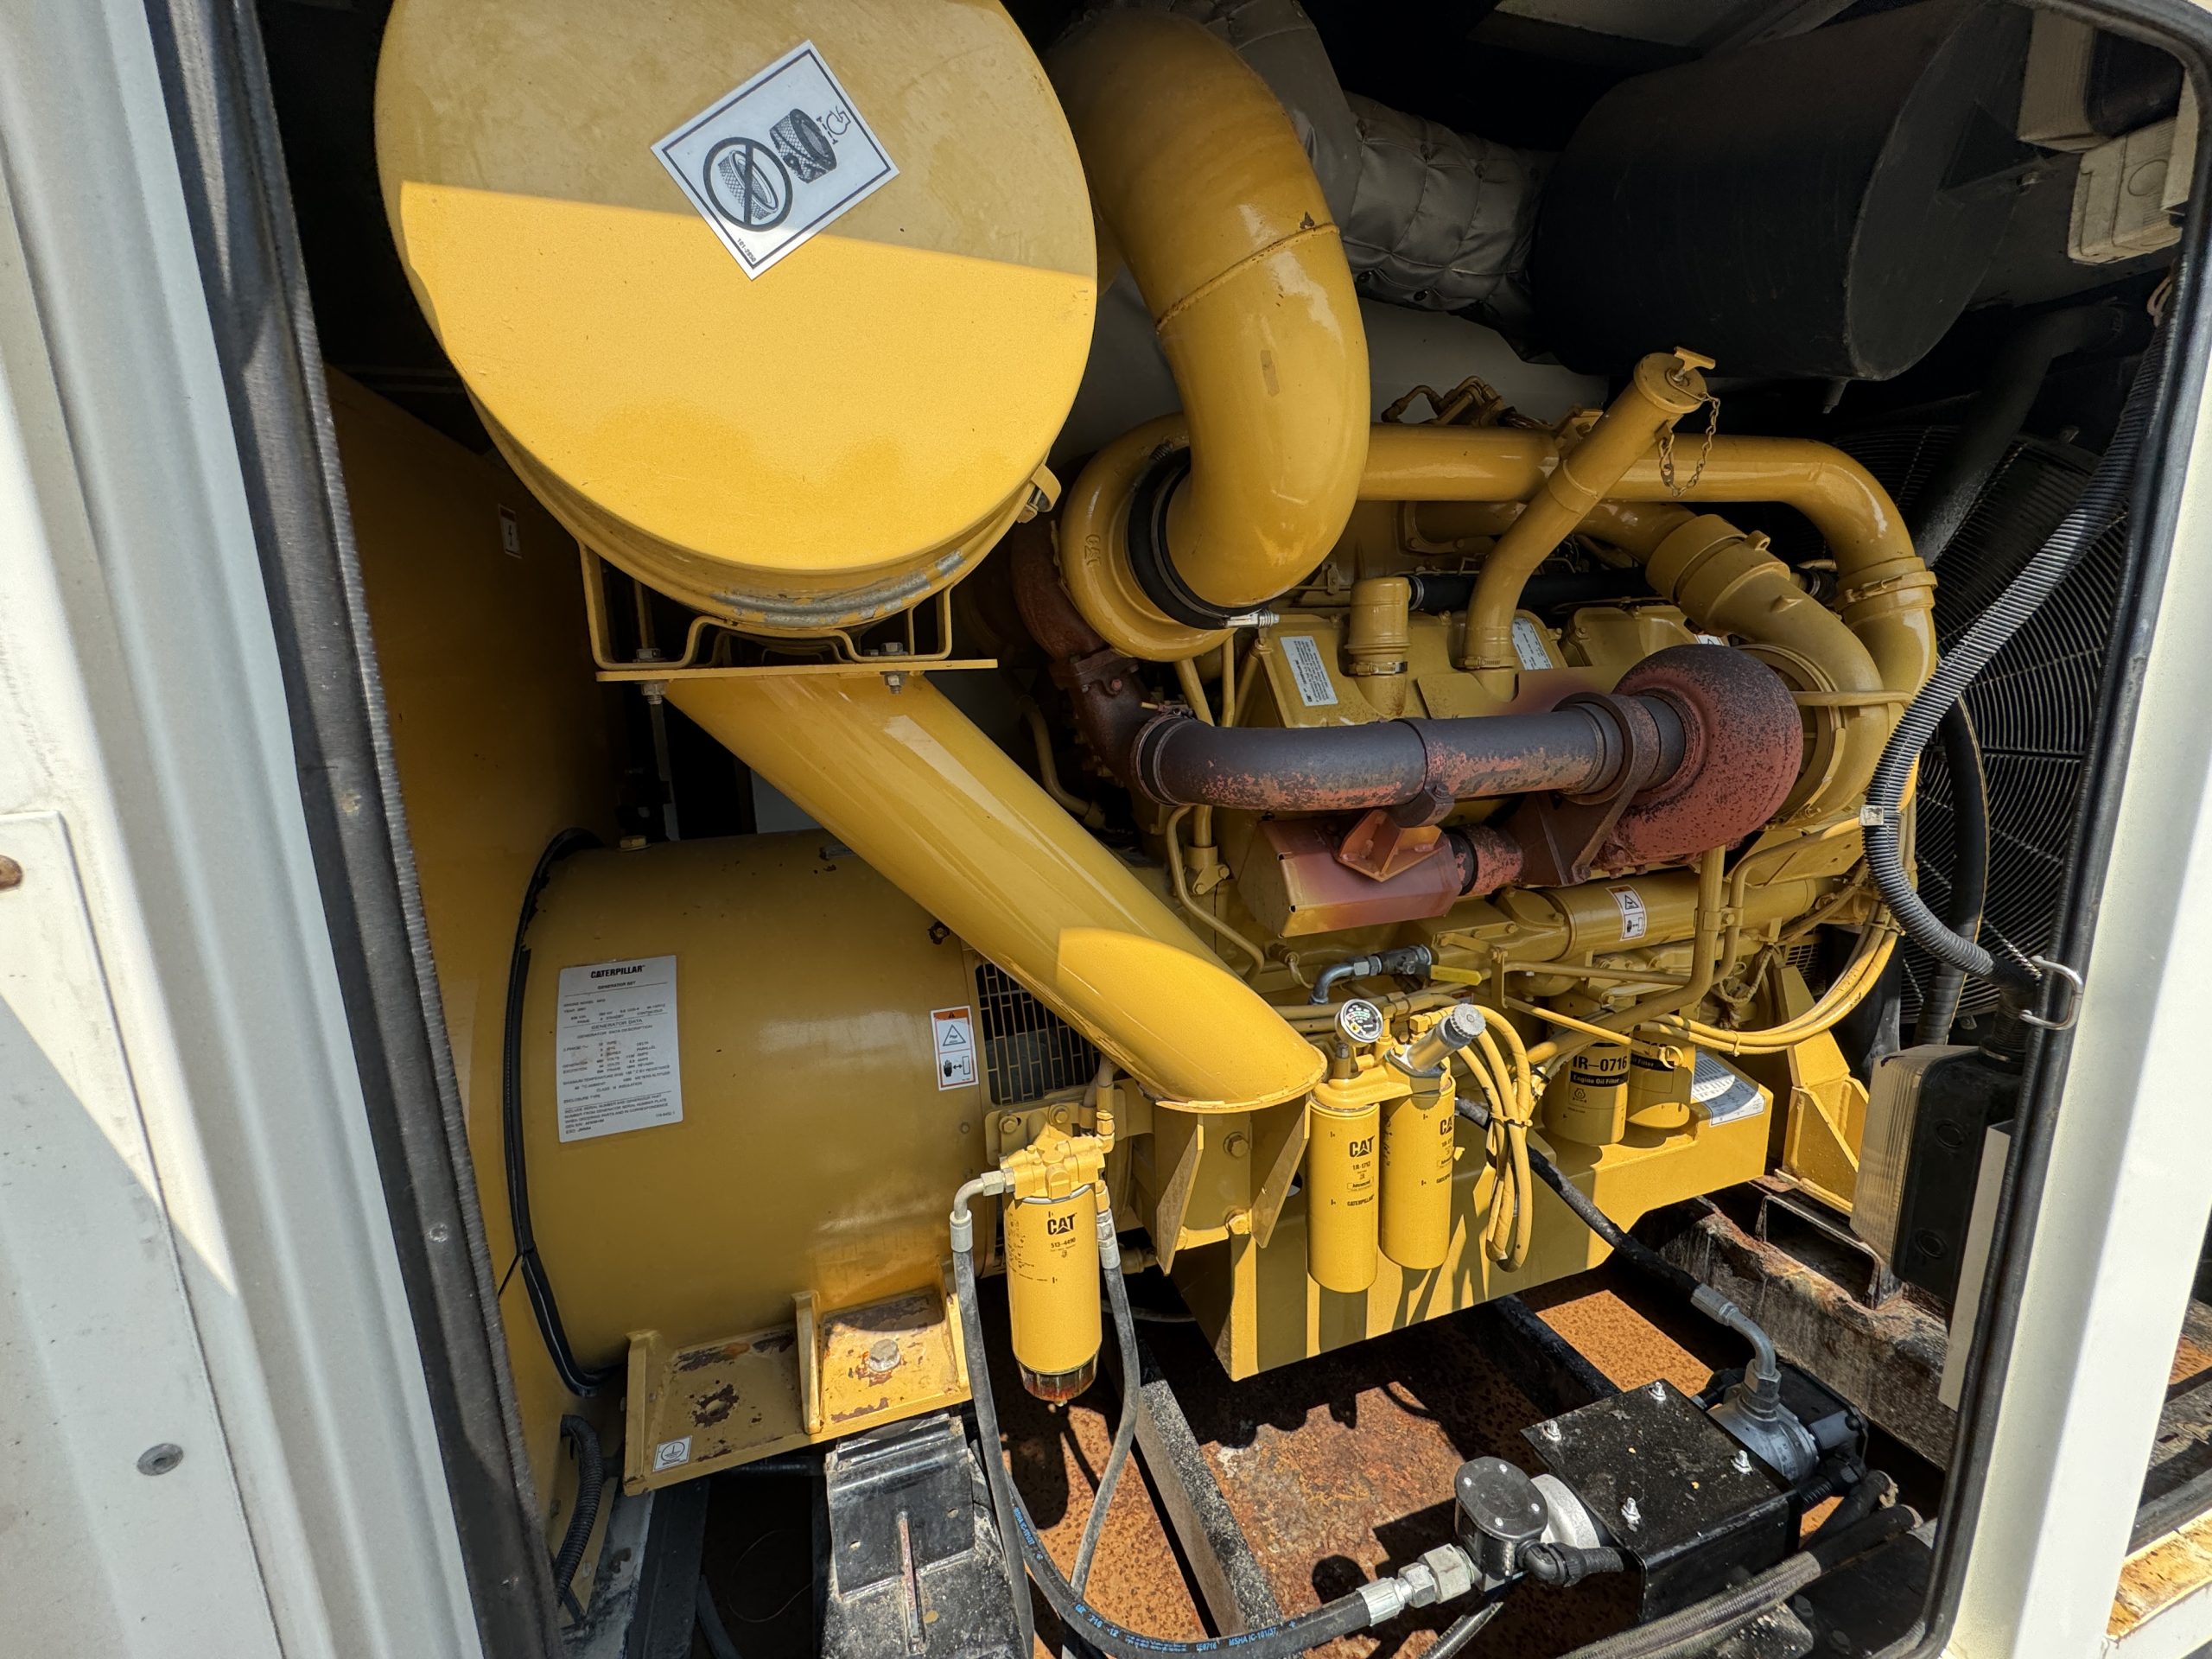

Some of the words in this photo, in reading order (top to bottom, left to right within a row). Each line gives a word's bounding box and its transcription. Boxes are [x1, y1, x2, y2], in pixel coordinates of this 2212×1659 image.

[590, 966, 643, 979] CATERPILLAR
[1573, 1074, 1595, 1084] Engine
[1349, 1135, 1376, 1158] CAT
[1047, 1213, 1077, 1236] CAT
[1089, 1614, 1103, 1629] 716
[1229, 1636, 1248, 1647] MSHA
